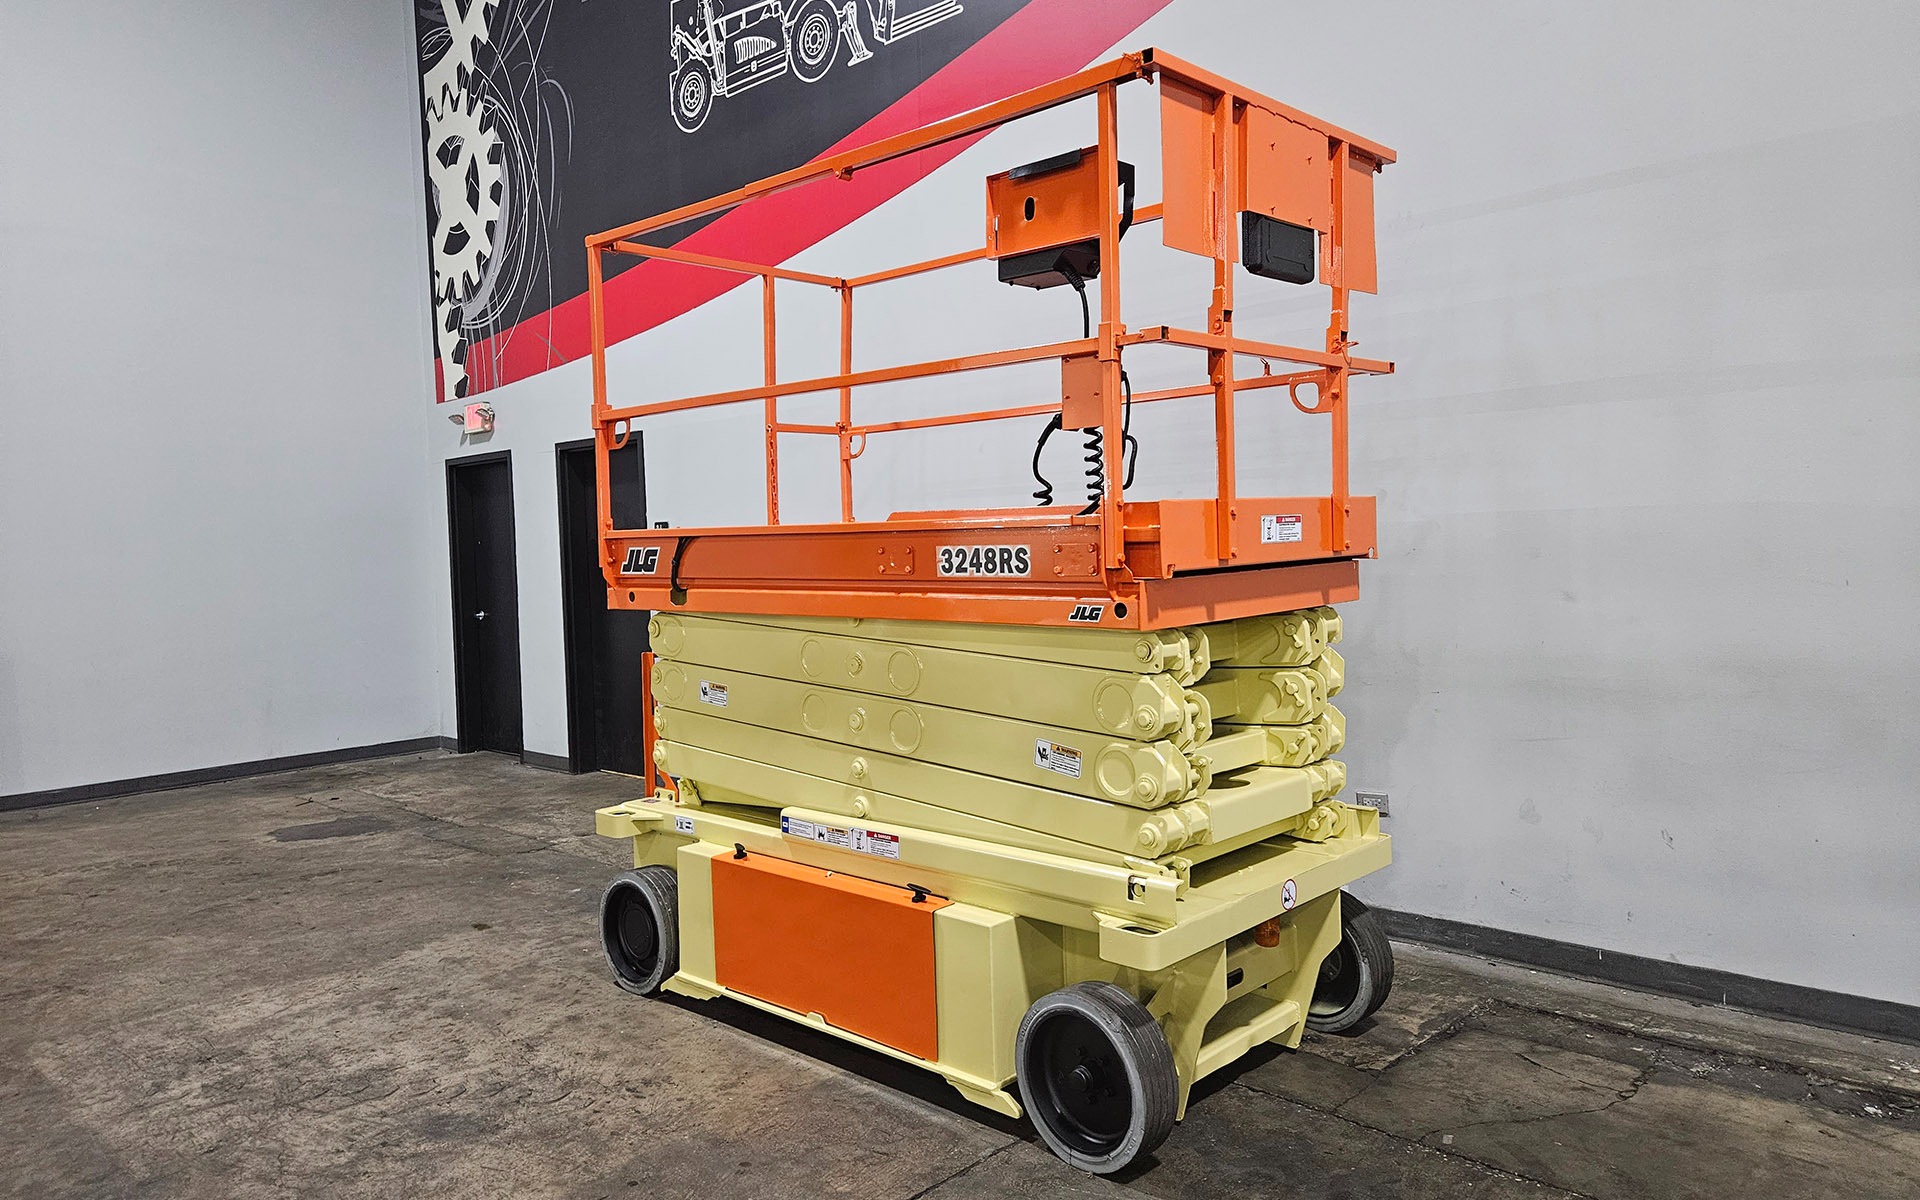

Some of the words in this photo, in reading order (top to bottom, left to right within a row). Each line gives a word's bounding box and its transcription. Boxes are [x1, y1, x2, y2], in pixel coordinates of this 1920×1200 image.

[621, 548, 659, 573] JLG
[940, 547, 1029, 574] 3248RS
[1069, 605, 1103, 621] JLG
